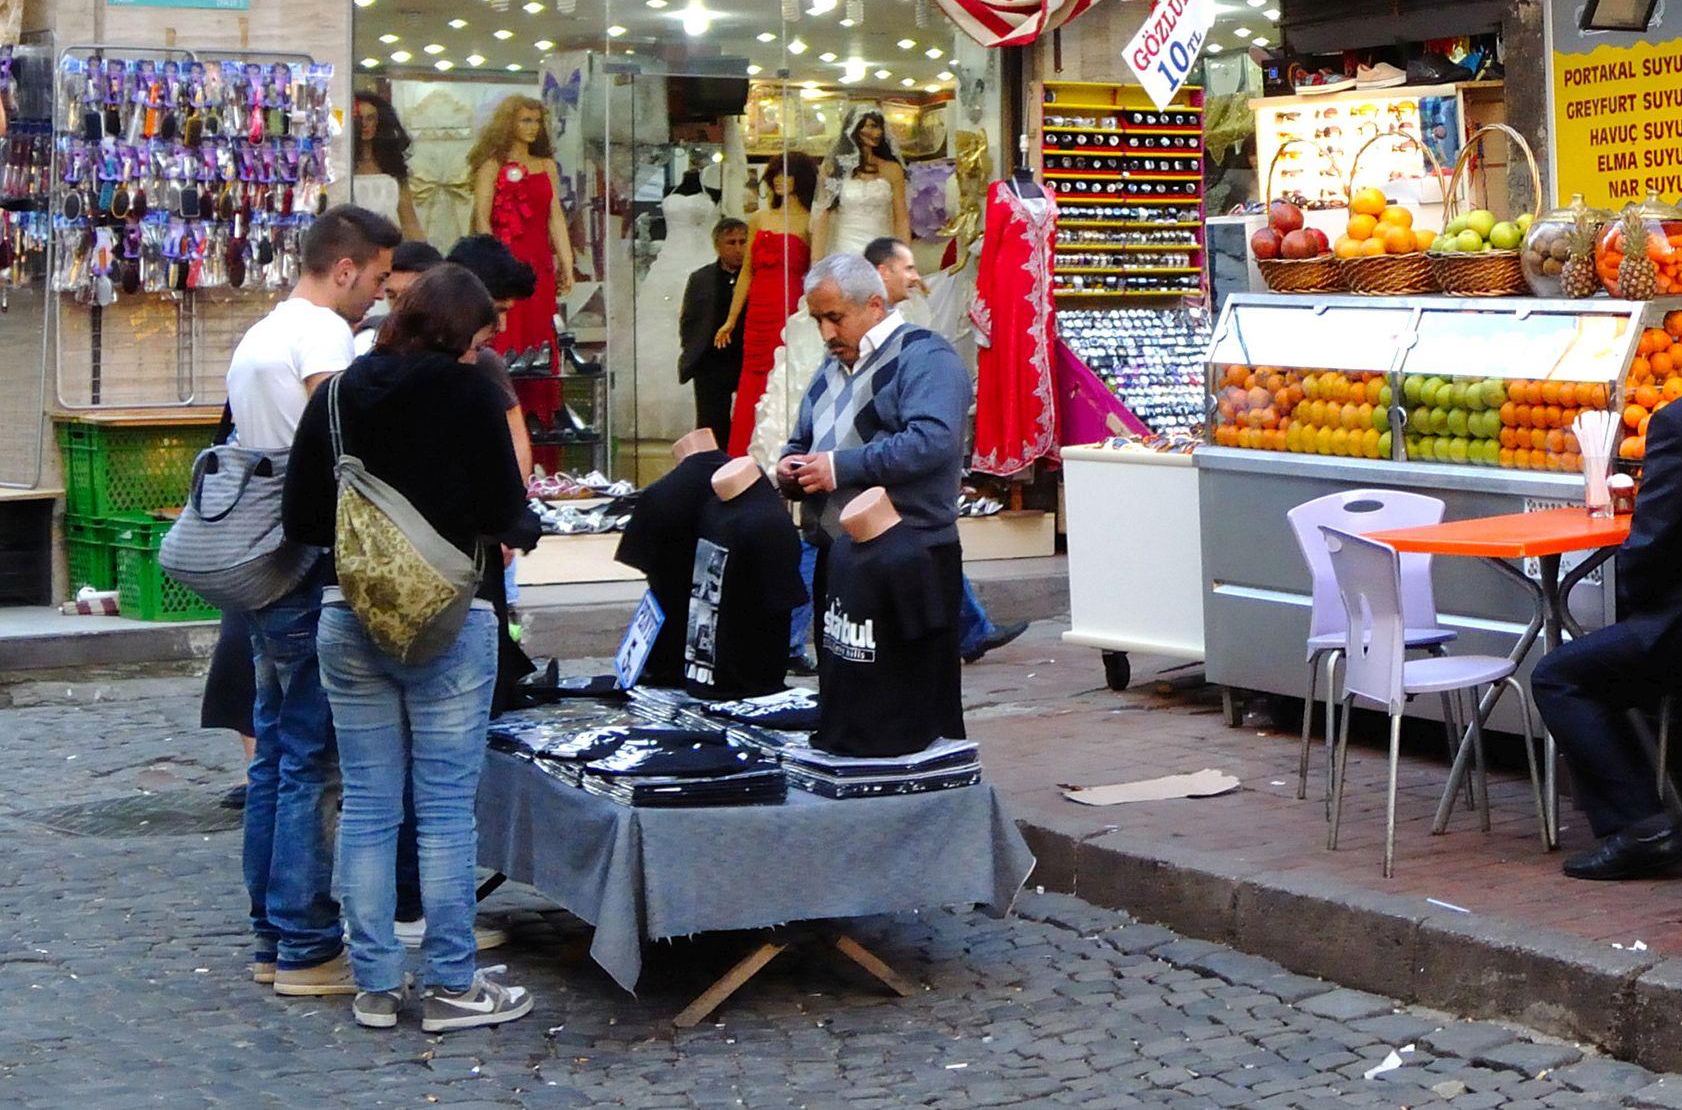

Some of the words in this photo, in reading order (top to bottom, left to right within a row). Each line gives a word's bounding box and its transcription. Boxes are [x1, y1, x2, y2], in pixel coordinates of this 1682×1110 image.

[1158, 40, 1190, 92] 10
[1564, 60, 1637, 88] PORTAKAL
[1566, 93, 1637, 120] GREYFURT
[1590, 123, 1638, 147] HAVUÇ
[1597, 150, 1638, 173] ELMA
[1608, 179, 1640, 199] NAR
